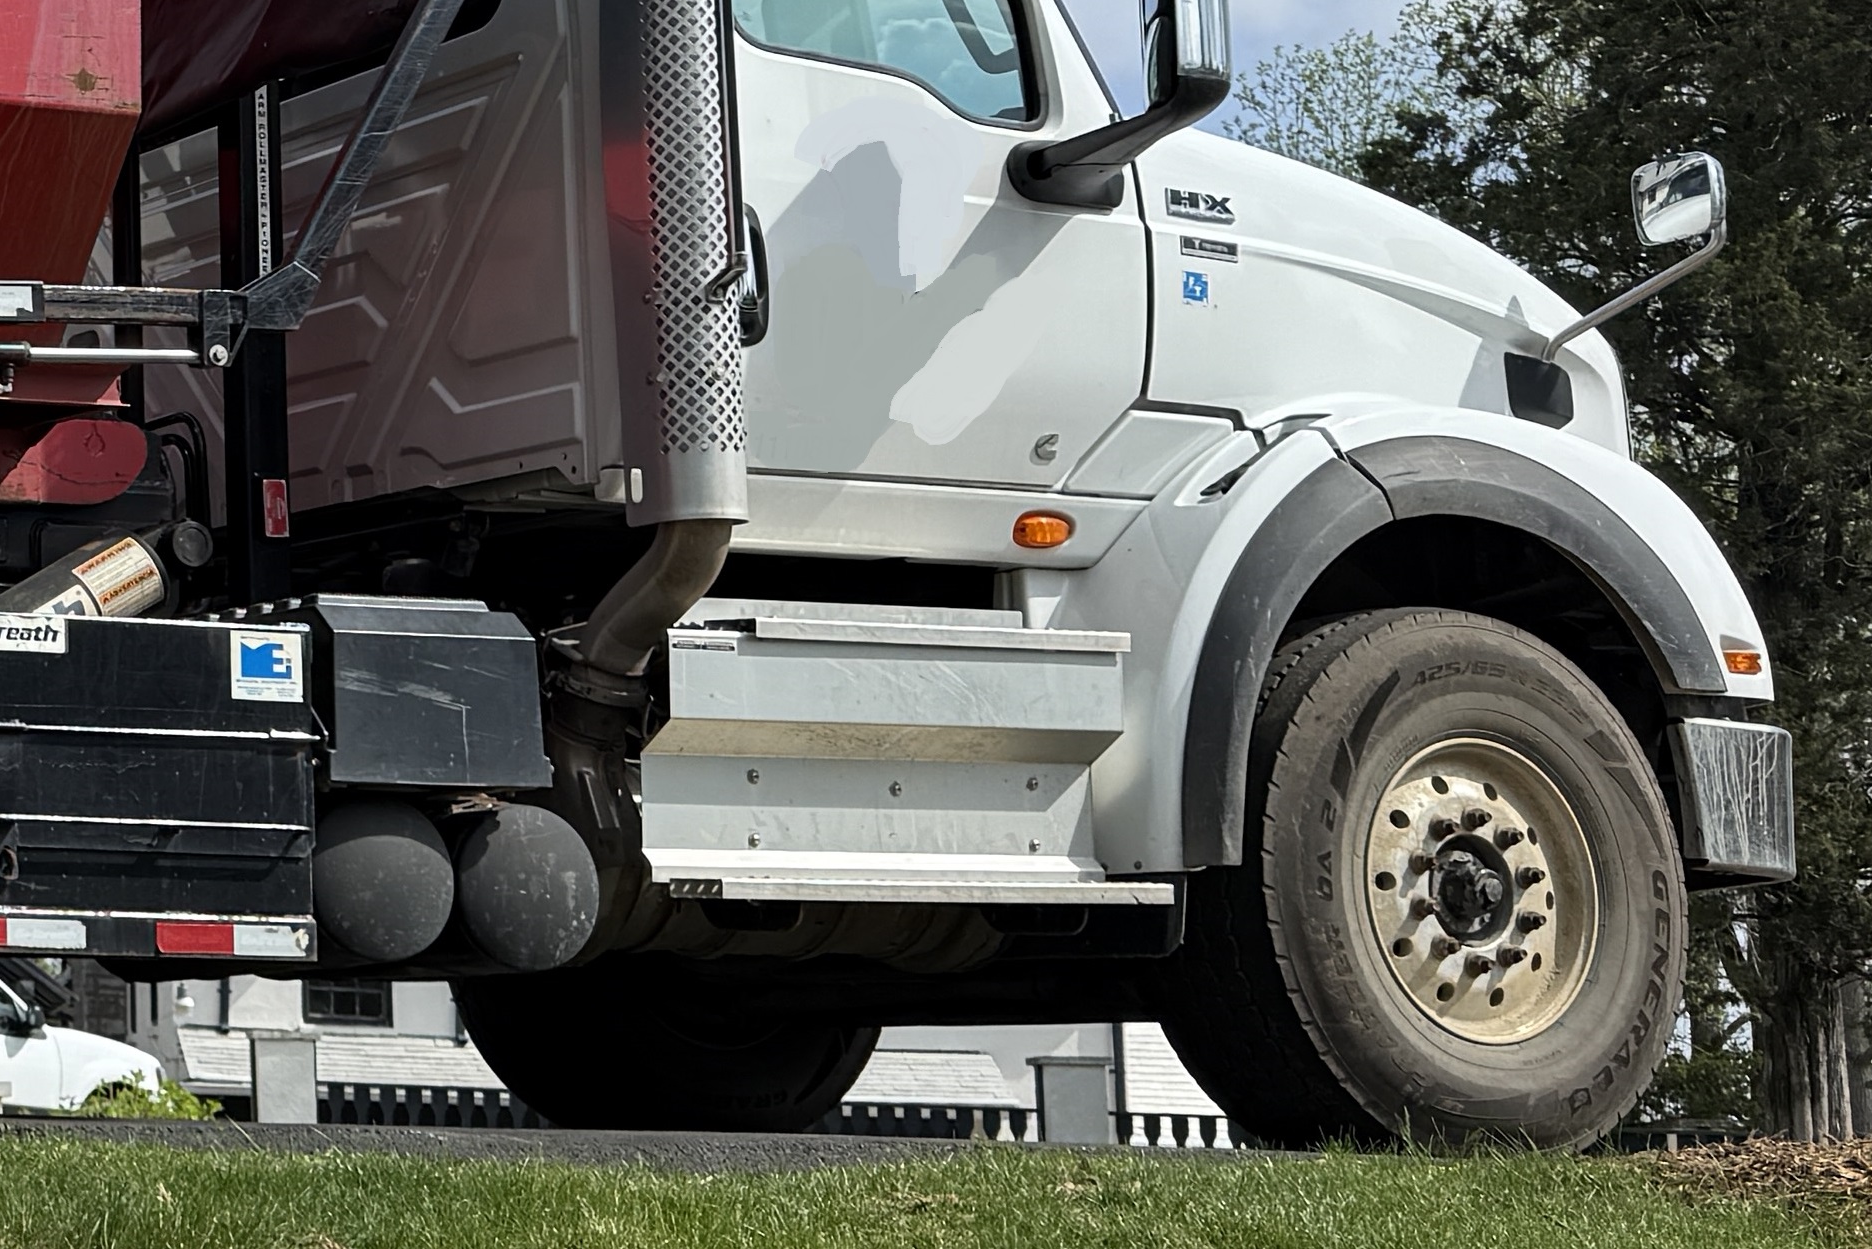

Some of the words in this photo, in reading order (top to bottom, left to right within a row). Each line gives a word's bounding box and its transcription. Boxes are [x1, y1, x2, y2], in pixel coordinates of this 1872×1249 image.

[1165, 188, 1236, 222] HX
[261, 221, 269, 276] PIONEE
[1592, 869, 1671, 1092] GENERAL
